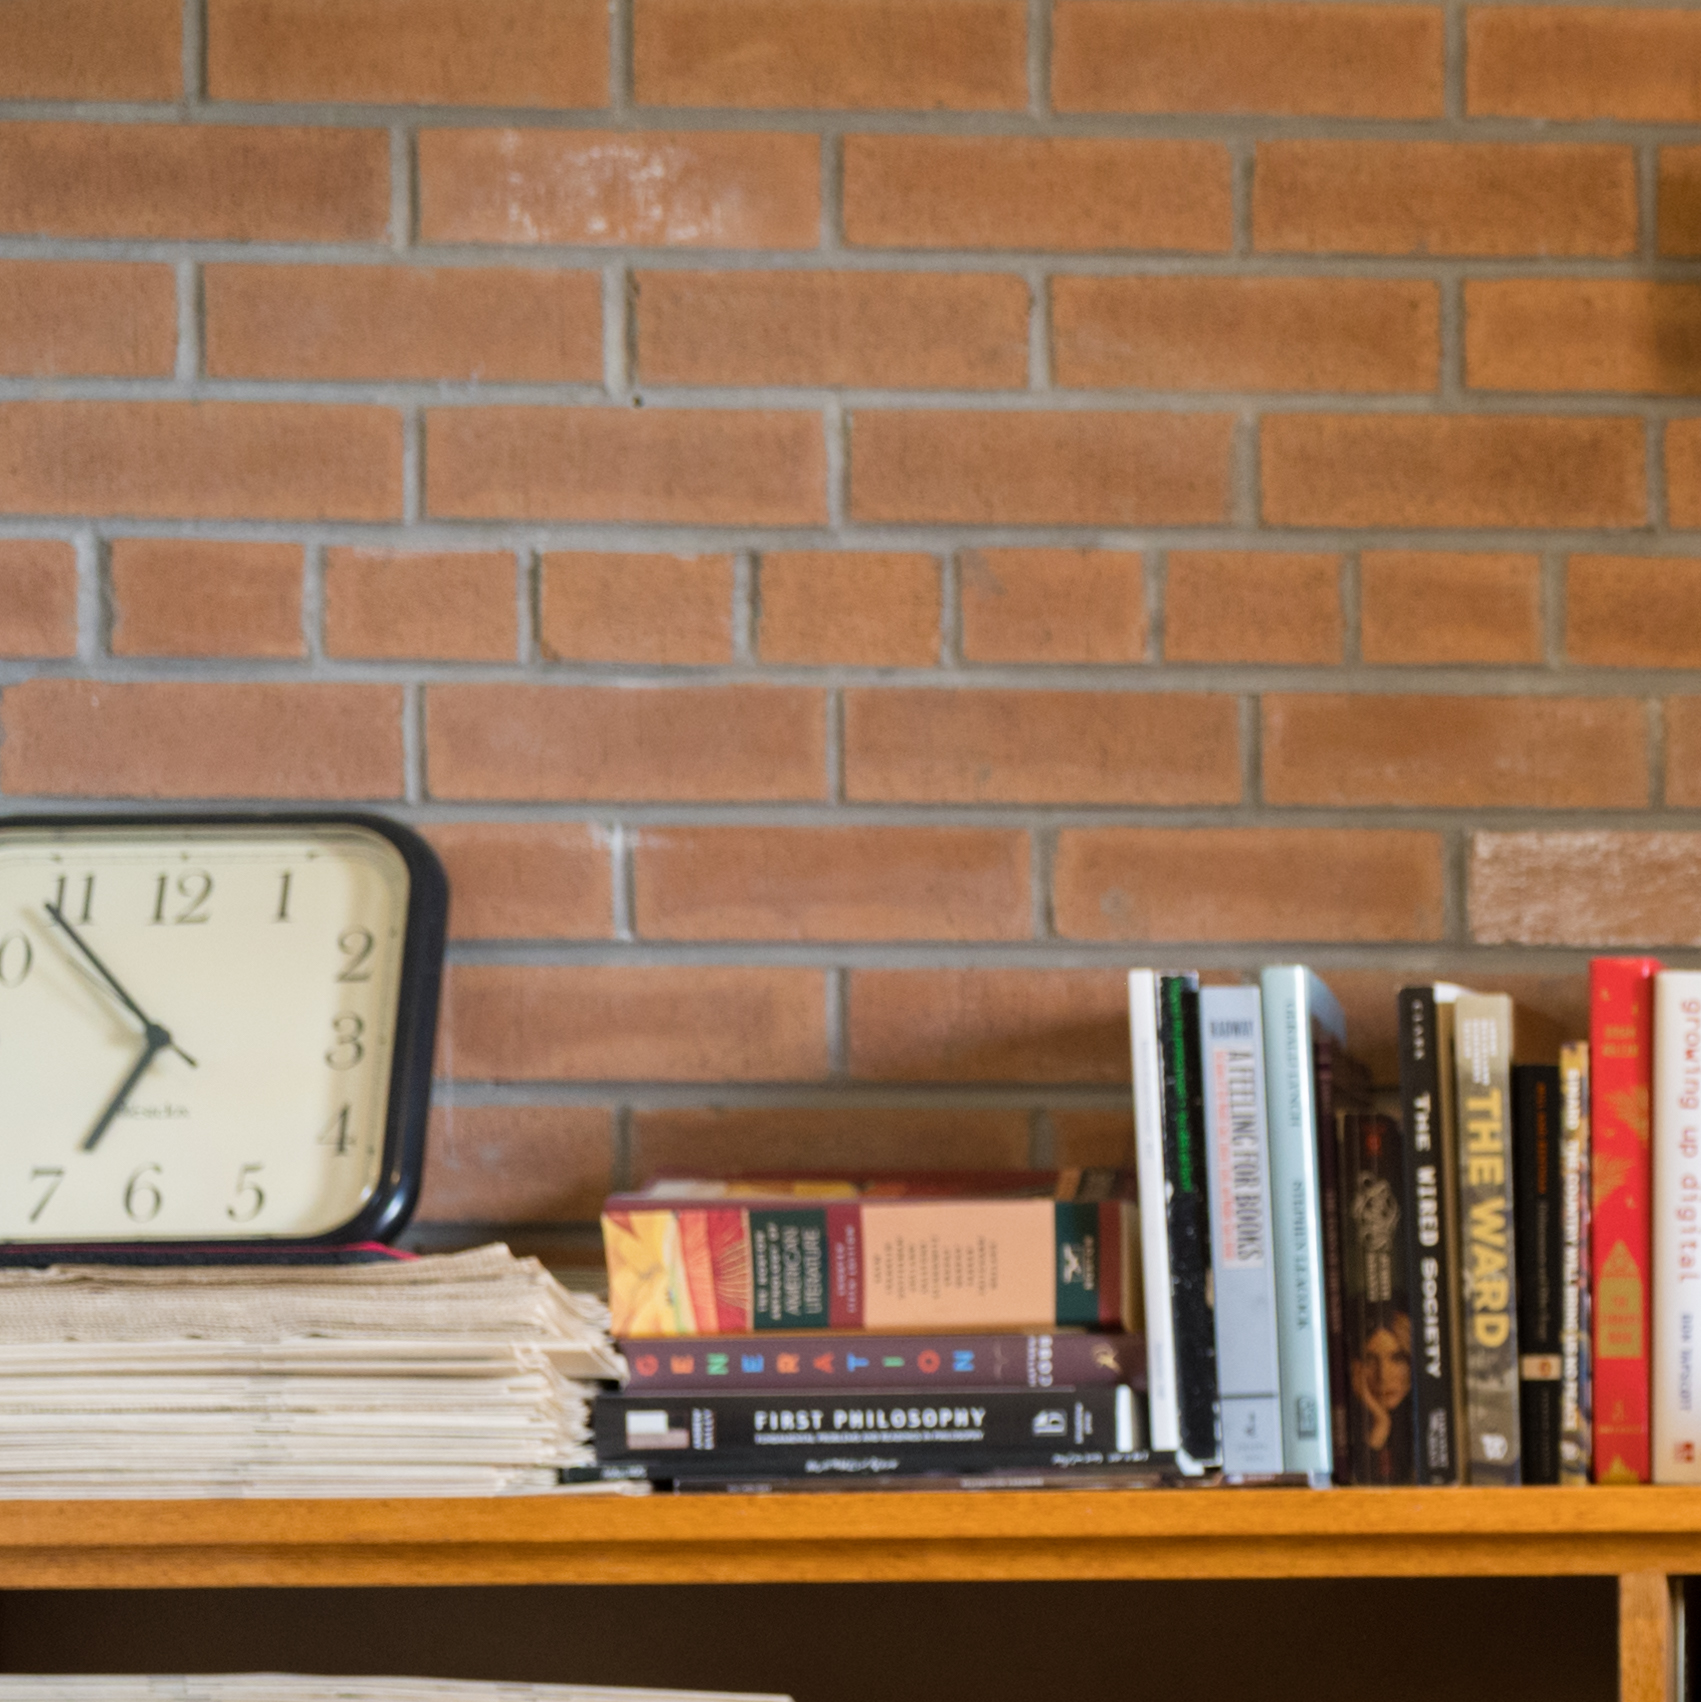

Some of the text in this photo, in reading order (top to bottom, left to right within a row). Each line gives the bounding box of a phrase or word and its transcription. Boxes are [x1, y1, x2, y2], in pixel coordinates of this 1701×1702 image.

[50, 874, 96, 926] 11
[152, 870, 214, 926] 12
[274, 871, 295, 923] 1
[0, 931, 33, 987] 0
[336, 926, 377, 983] 2
[326, 1012, 366, 1070] 3
[318, 1103, 356, 1157] 4
[1229, 1067, 1259, 1148] FEELING
[1234, 1151, 1261, 1188] FOR
[1681, 1127, 1699, 1158] up
[28, 1166, 65, 1222] 7
[123, 1164, 163, 1222] 6
[227, 1164, 267, 1222] 5
[1291, 1181, 1308, 1251] STEPHEN
[1466, 1088, 1509, 1348] THE WARD
[1565, 1173, 1580, 1243] COUNTRY
[1236, 1194, 1264, 1262] BOOKS
[1414, 1093, 1441, 1379] THE WIRED SOCIETY
[782, 1225, 803, 1317] AMERICAN
[801, 1226, 823, 1315] LITERATURE
[1565, 1245, 1579, 1284] WILL
[1565, 1286, 1579, 1333] BRING
[754, 1406, 986, 1431] FIRST PHILOSOPHY
[1564, 1382, 1579, 1431] PEACE
